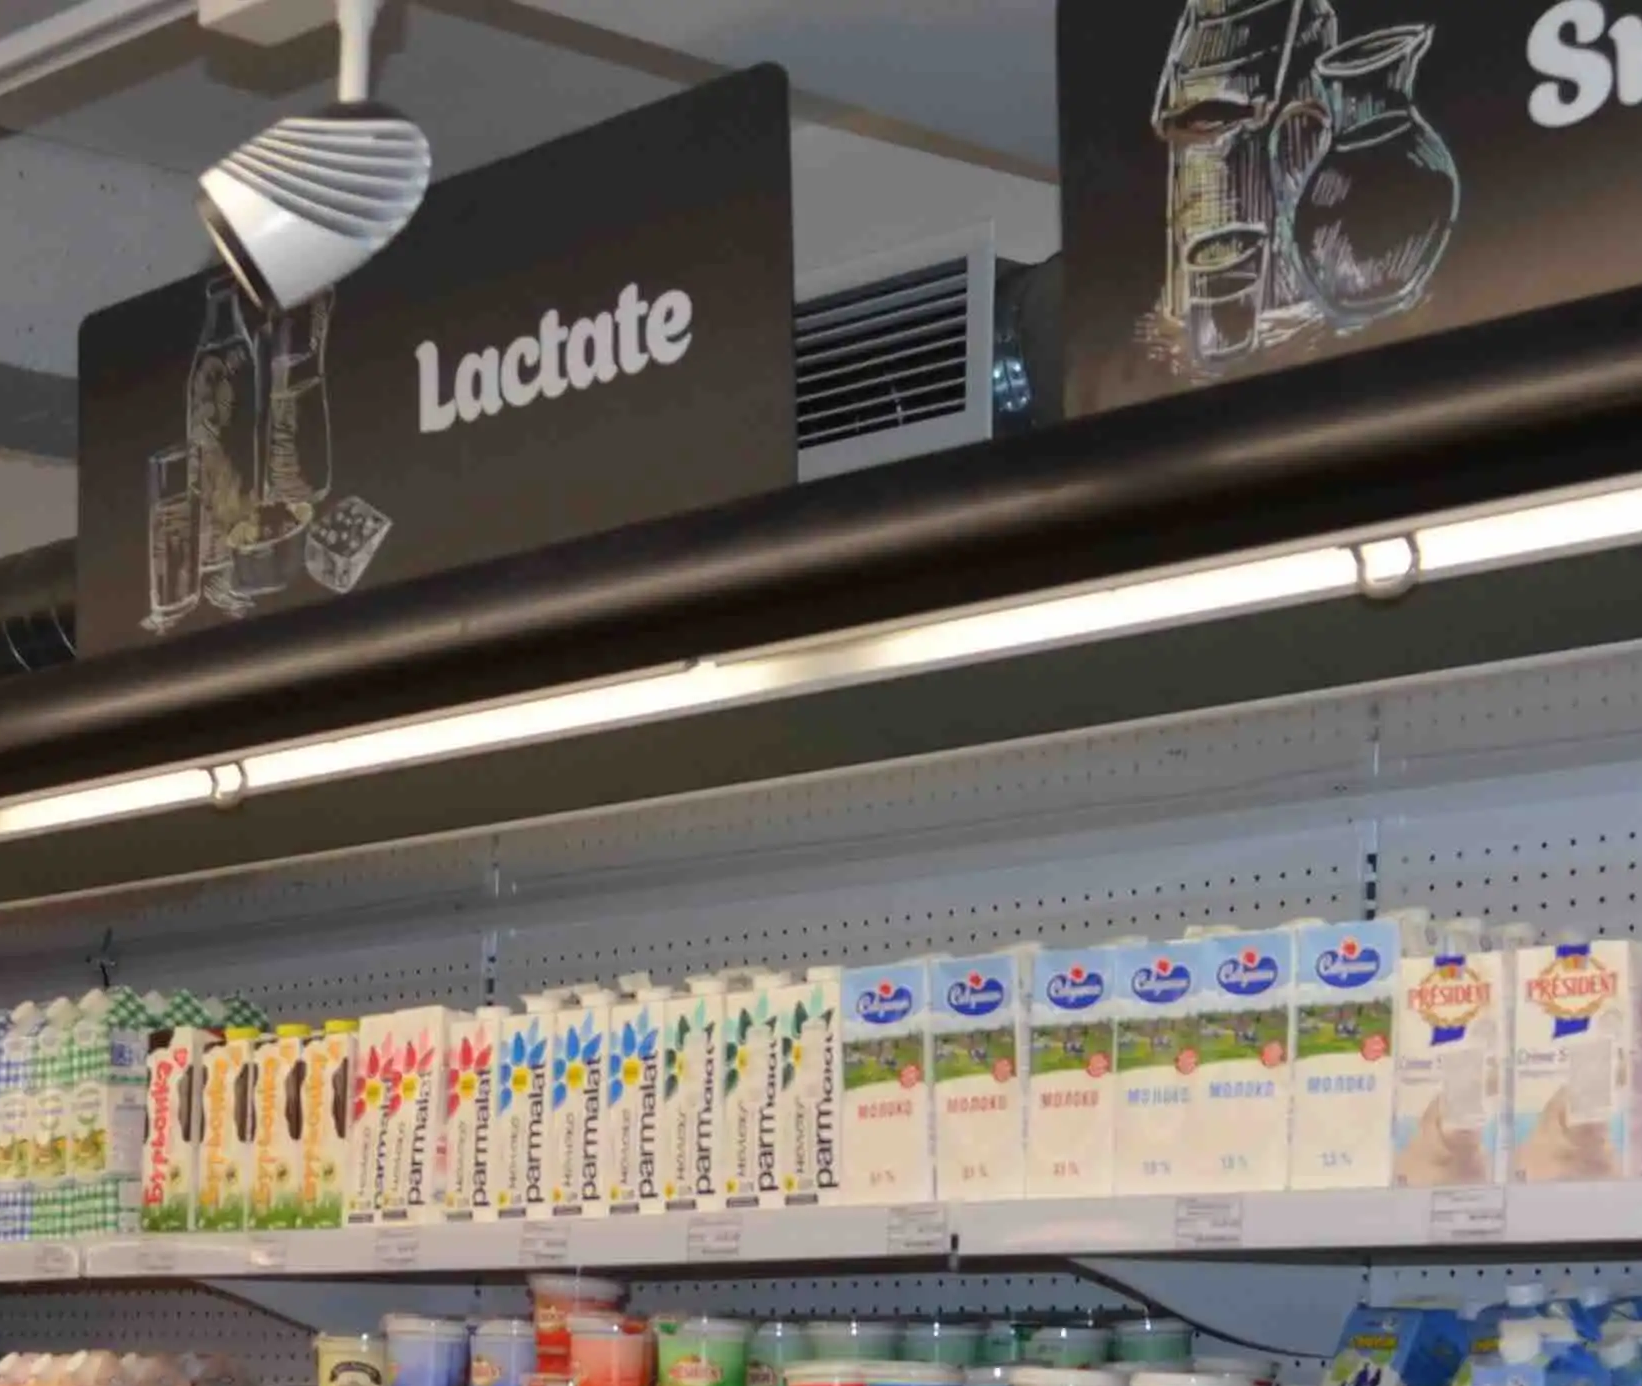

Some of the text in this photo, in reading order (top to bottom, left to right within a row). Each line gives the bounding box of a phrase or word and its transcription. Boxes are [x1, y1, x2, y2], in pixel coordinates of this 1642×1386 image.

[415, 282, 694, 433] Lactate
[408, 1070, 432, 1206] parmalat
[472, 1068, 491, 1207] parmalat
[526, 1062, 546, 1204] parmalat
[581, 1055, 600, 1202] parmalat
[639, 1051, 659, 1200] parmalat
